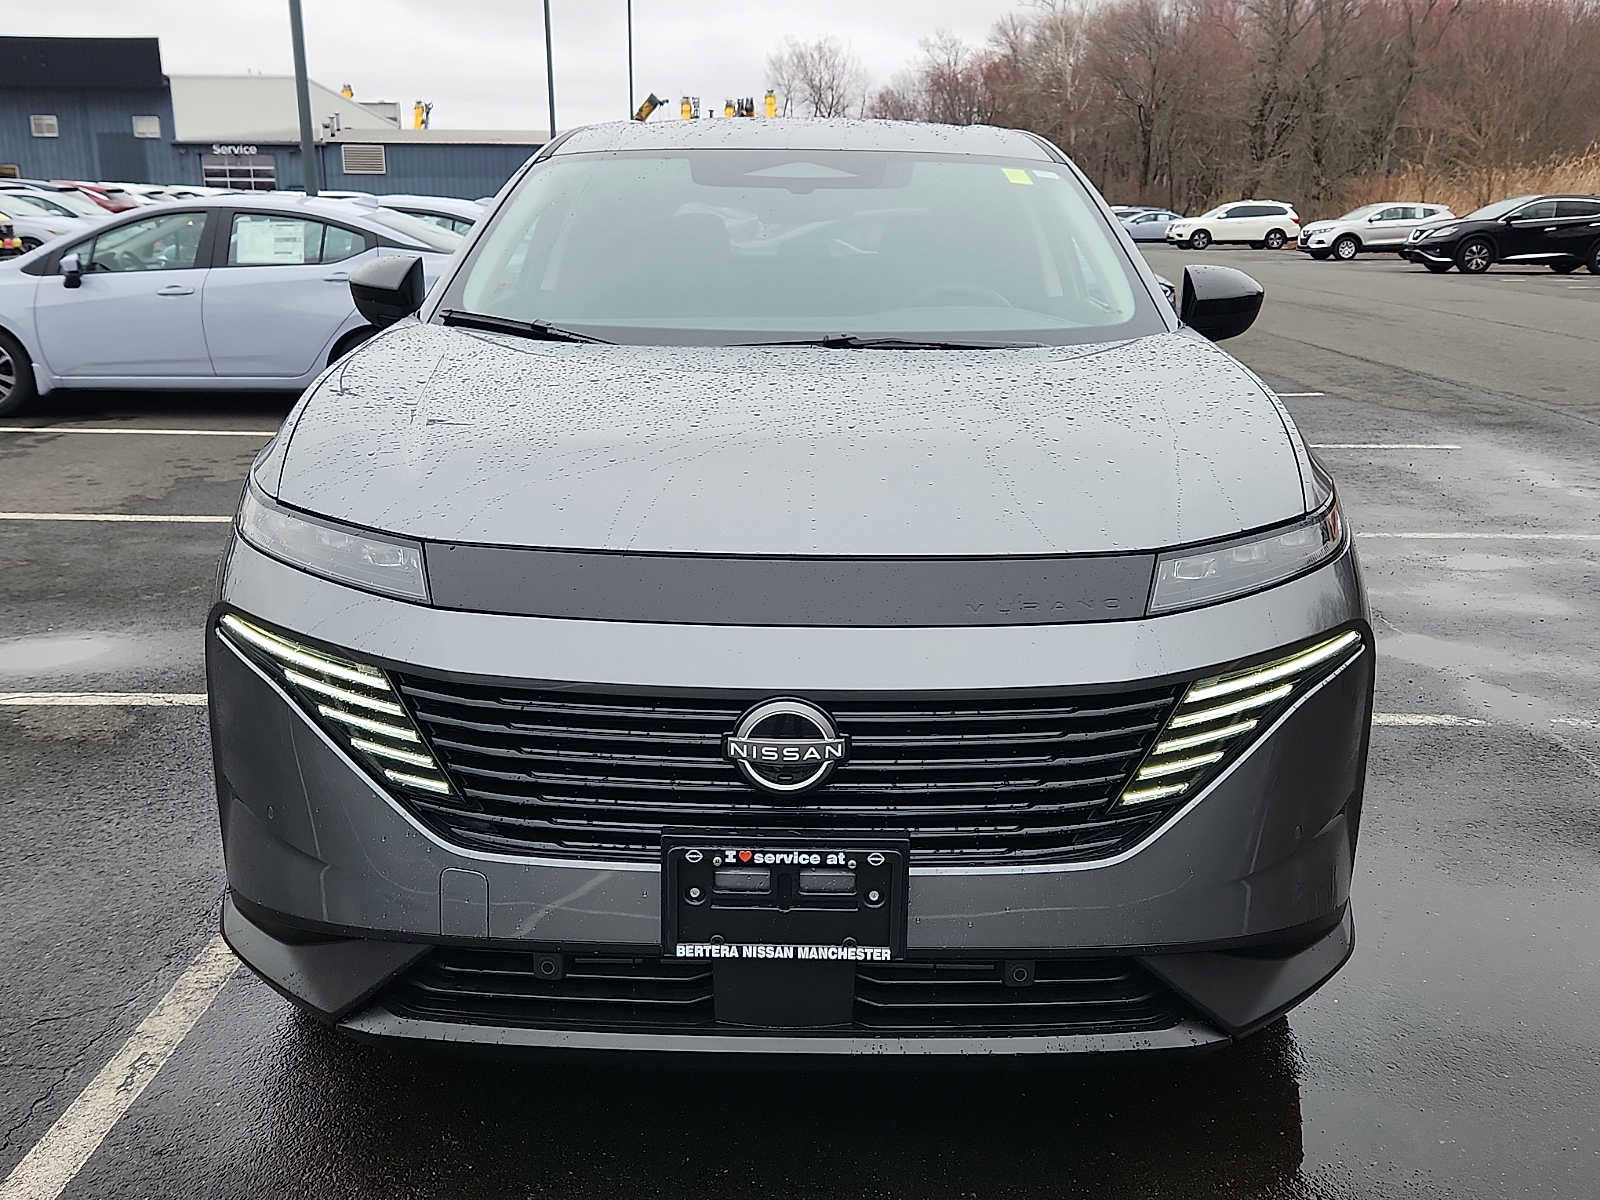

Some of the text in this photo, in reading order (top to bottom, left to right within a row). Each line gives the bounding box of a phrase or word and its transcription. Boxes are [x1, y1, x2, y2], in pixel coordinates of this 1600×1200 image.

[212, 144, 257, 154] Service
[729, 742, 842, 760] NISSAN
[724, 850, 845, 865] I service at
[676, 945, 891, 961] BERTERA NISSAN MANCHESTER
